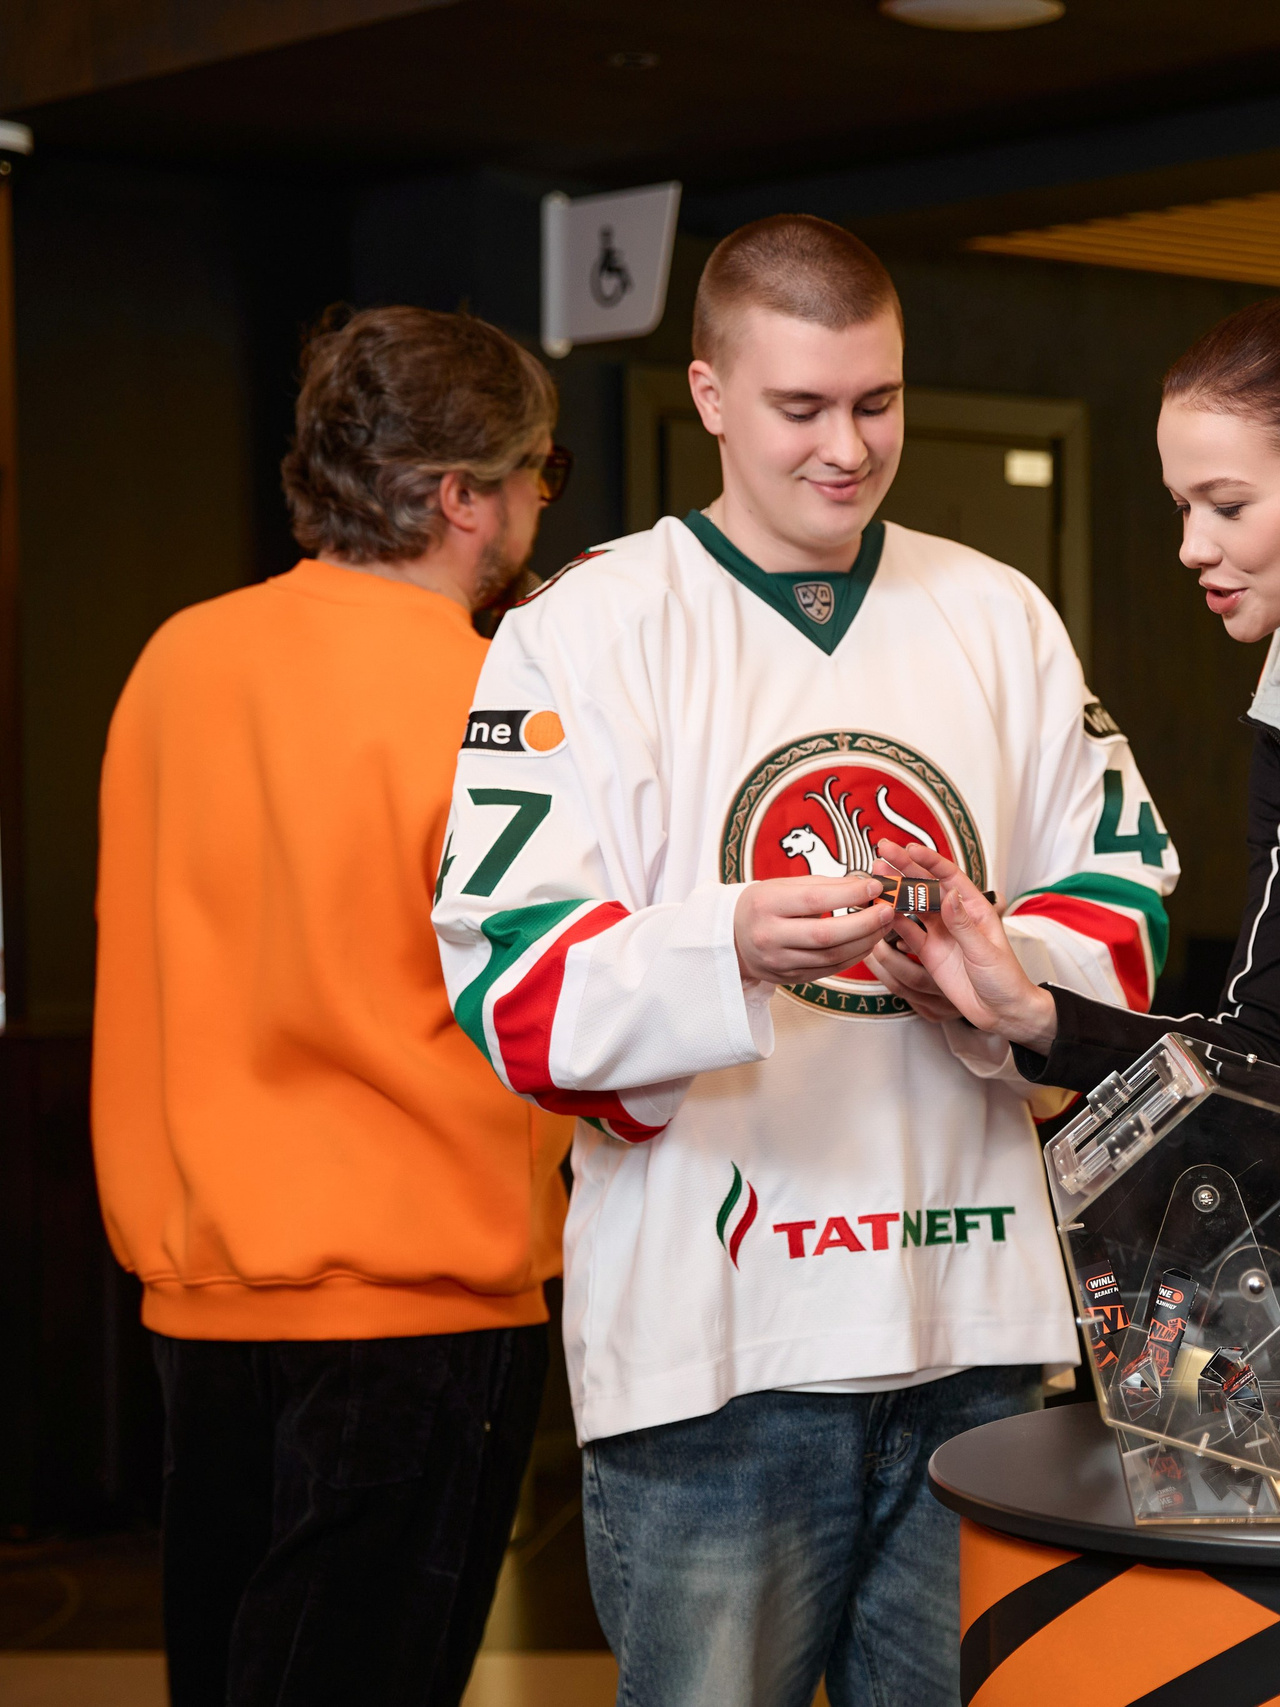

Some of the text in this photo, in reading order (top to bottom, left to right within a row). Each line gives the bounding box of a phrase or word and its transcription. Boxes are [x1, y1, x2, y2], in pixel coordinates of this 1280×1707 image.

[1094, 769, 1170, 868] 4
[800, 982, 905, 1012] ТАТАРС
[772, 1205, 1016, 1260] TATNEFT
